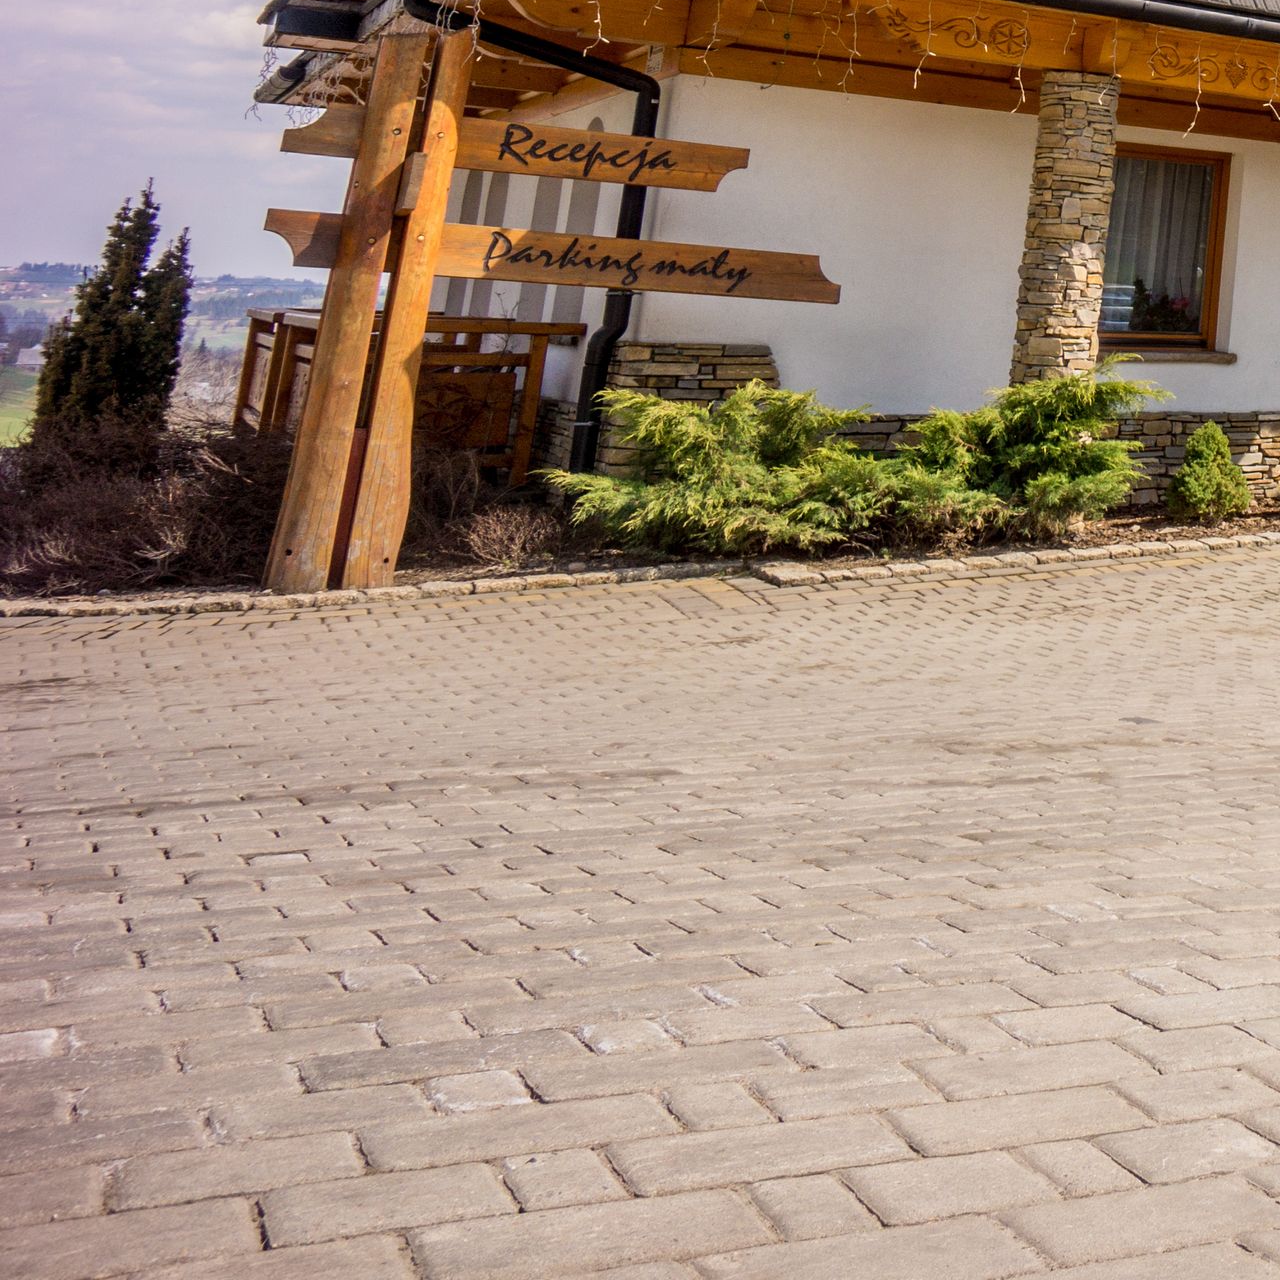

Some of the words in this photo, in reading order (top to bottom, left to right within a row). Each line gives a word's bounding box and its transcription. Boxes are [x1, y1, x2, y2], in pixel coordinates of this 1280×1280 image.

[498, 123, 678, 182] Recepcja
[483, 231, 643, 286] Parking
[649, 249, 752, 293] mały
